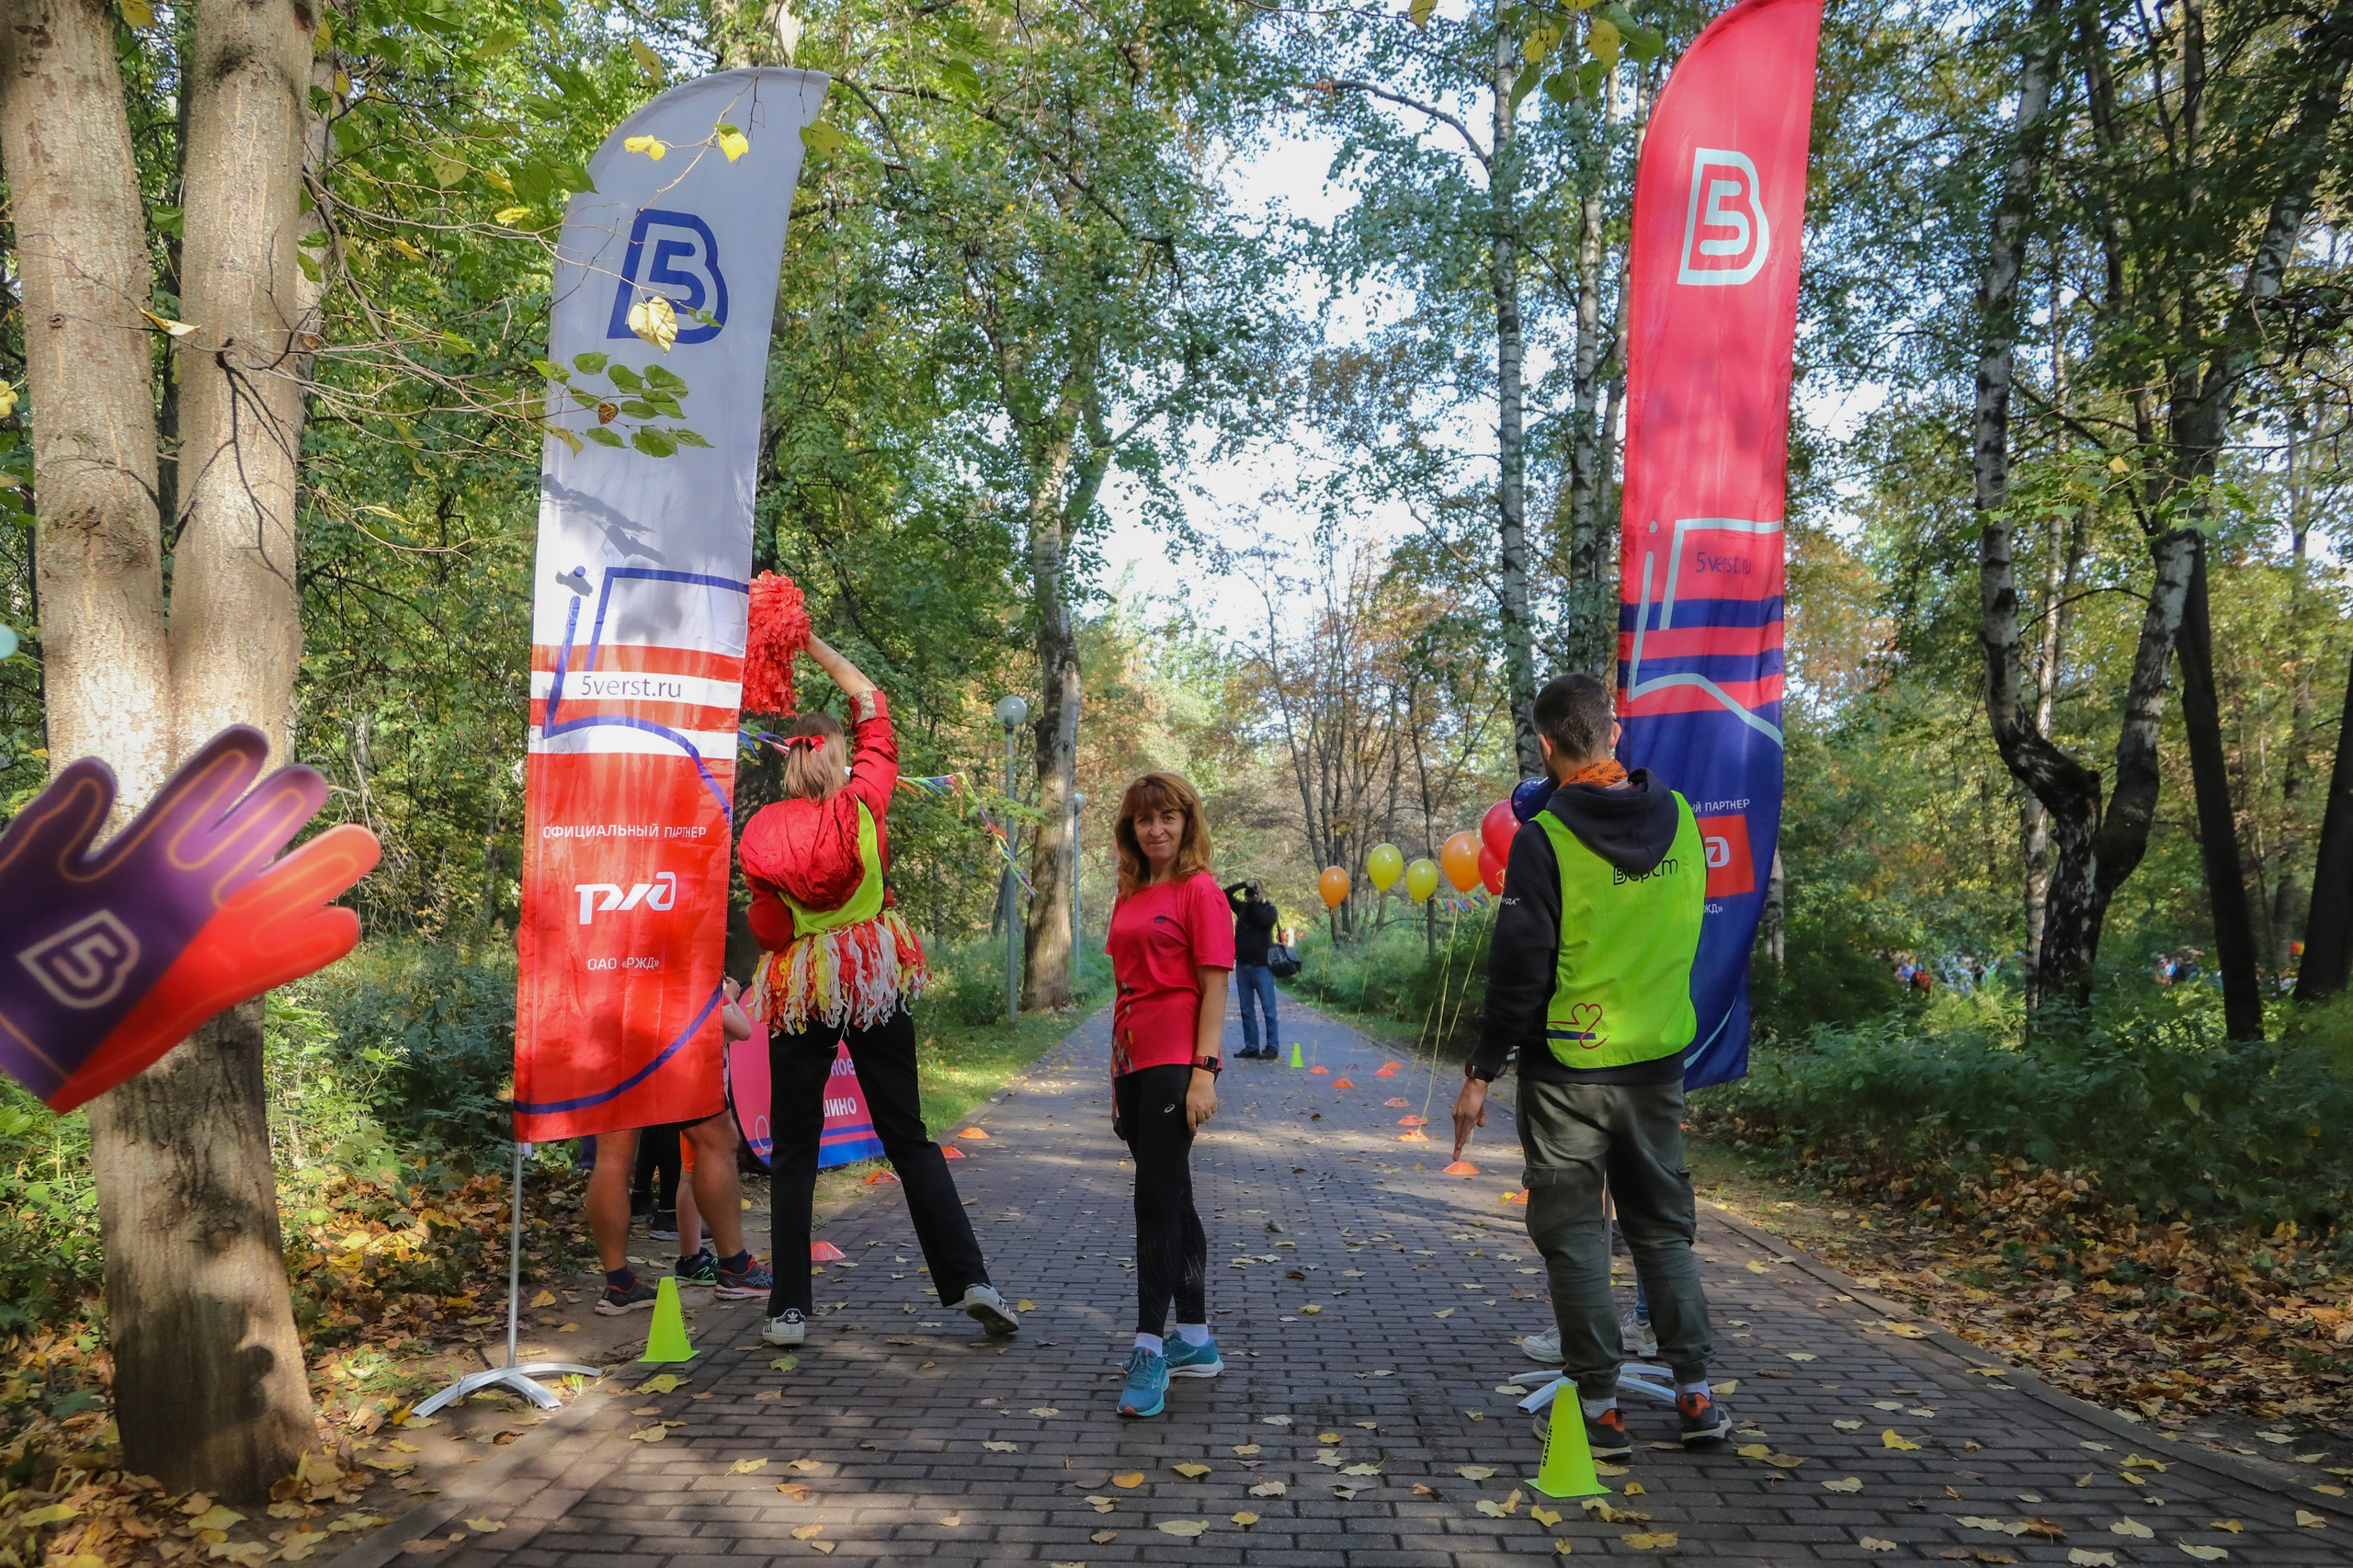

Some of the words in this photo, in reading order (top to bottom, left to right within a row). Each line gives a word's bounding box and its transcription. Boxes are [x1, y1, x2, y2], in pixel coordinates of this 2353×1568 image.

[1696, 551, 1752, 574] 5verst.ru
[581, 676, 682, 698] 5verst.ru
[1705, 799, 1750, 812] ПАРТНЕР
[543, 824, 659, 839] ОФИЦИАЛЬНЫЙ
[664, 826, 707, 838] ПАРТНЕР
[587, 958, 617, 971] ОАО
[621, 957, 660, 971] «РЖД»
